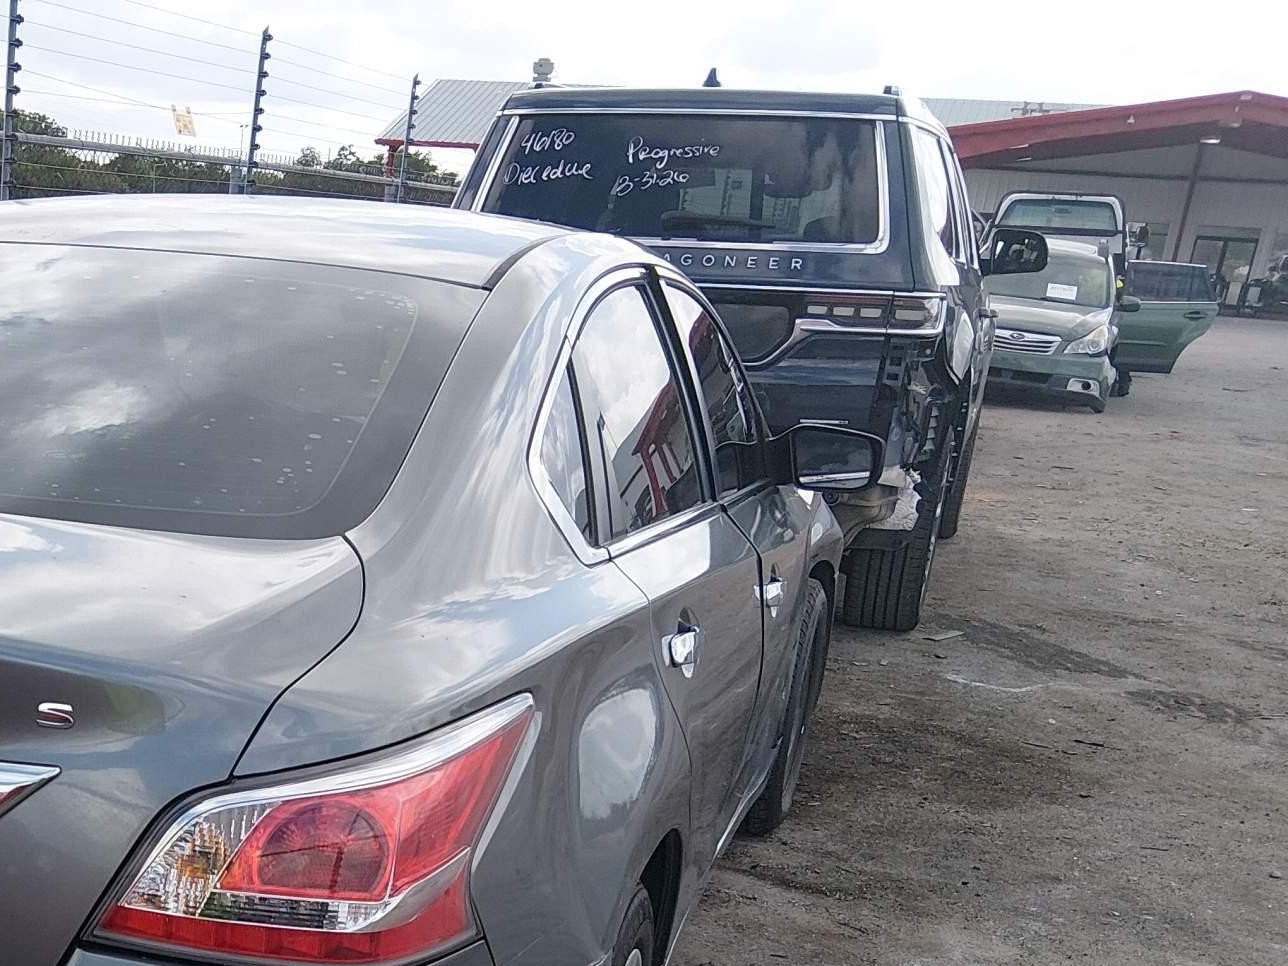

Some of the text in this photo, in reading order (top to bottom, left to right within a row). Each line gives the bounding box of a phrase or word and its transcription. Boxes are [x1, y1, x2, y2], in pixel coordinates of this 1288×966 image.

[520, 128, 575, 155] 46180
[626, 136, 720, 169] Progressive
[663, 253, 803, 270] AGONEER
[36, 702, 74, 729] S
